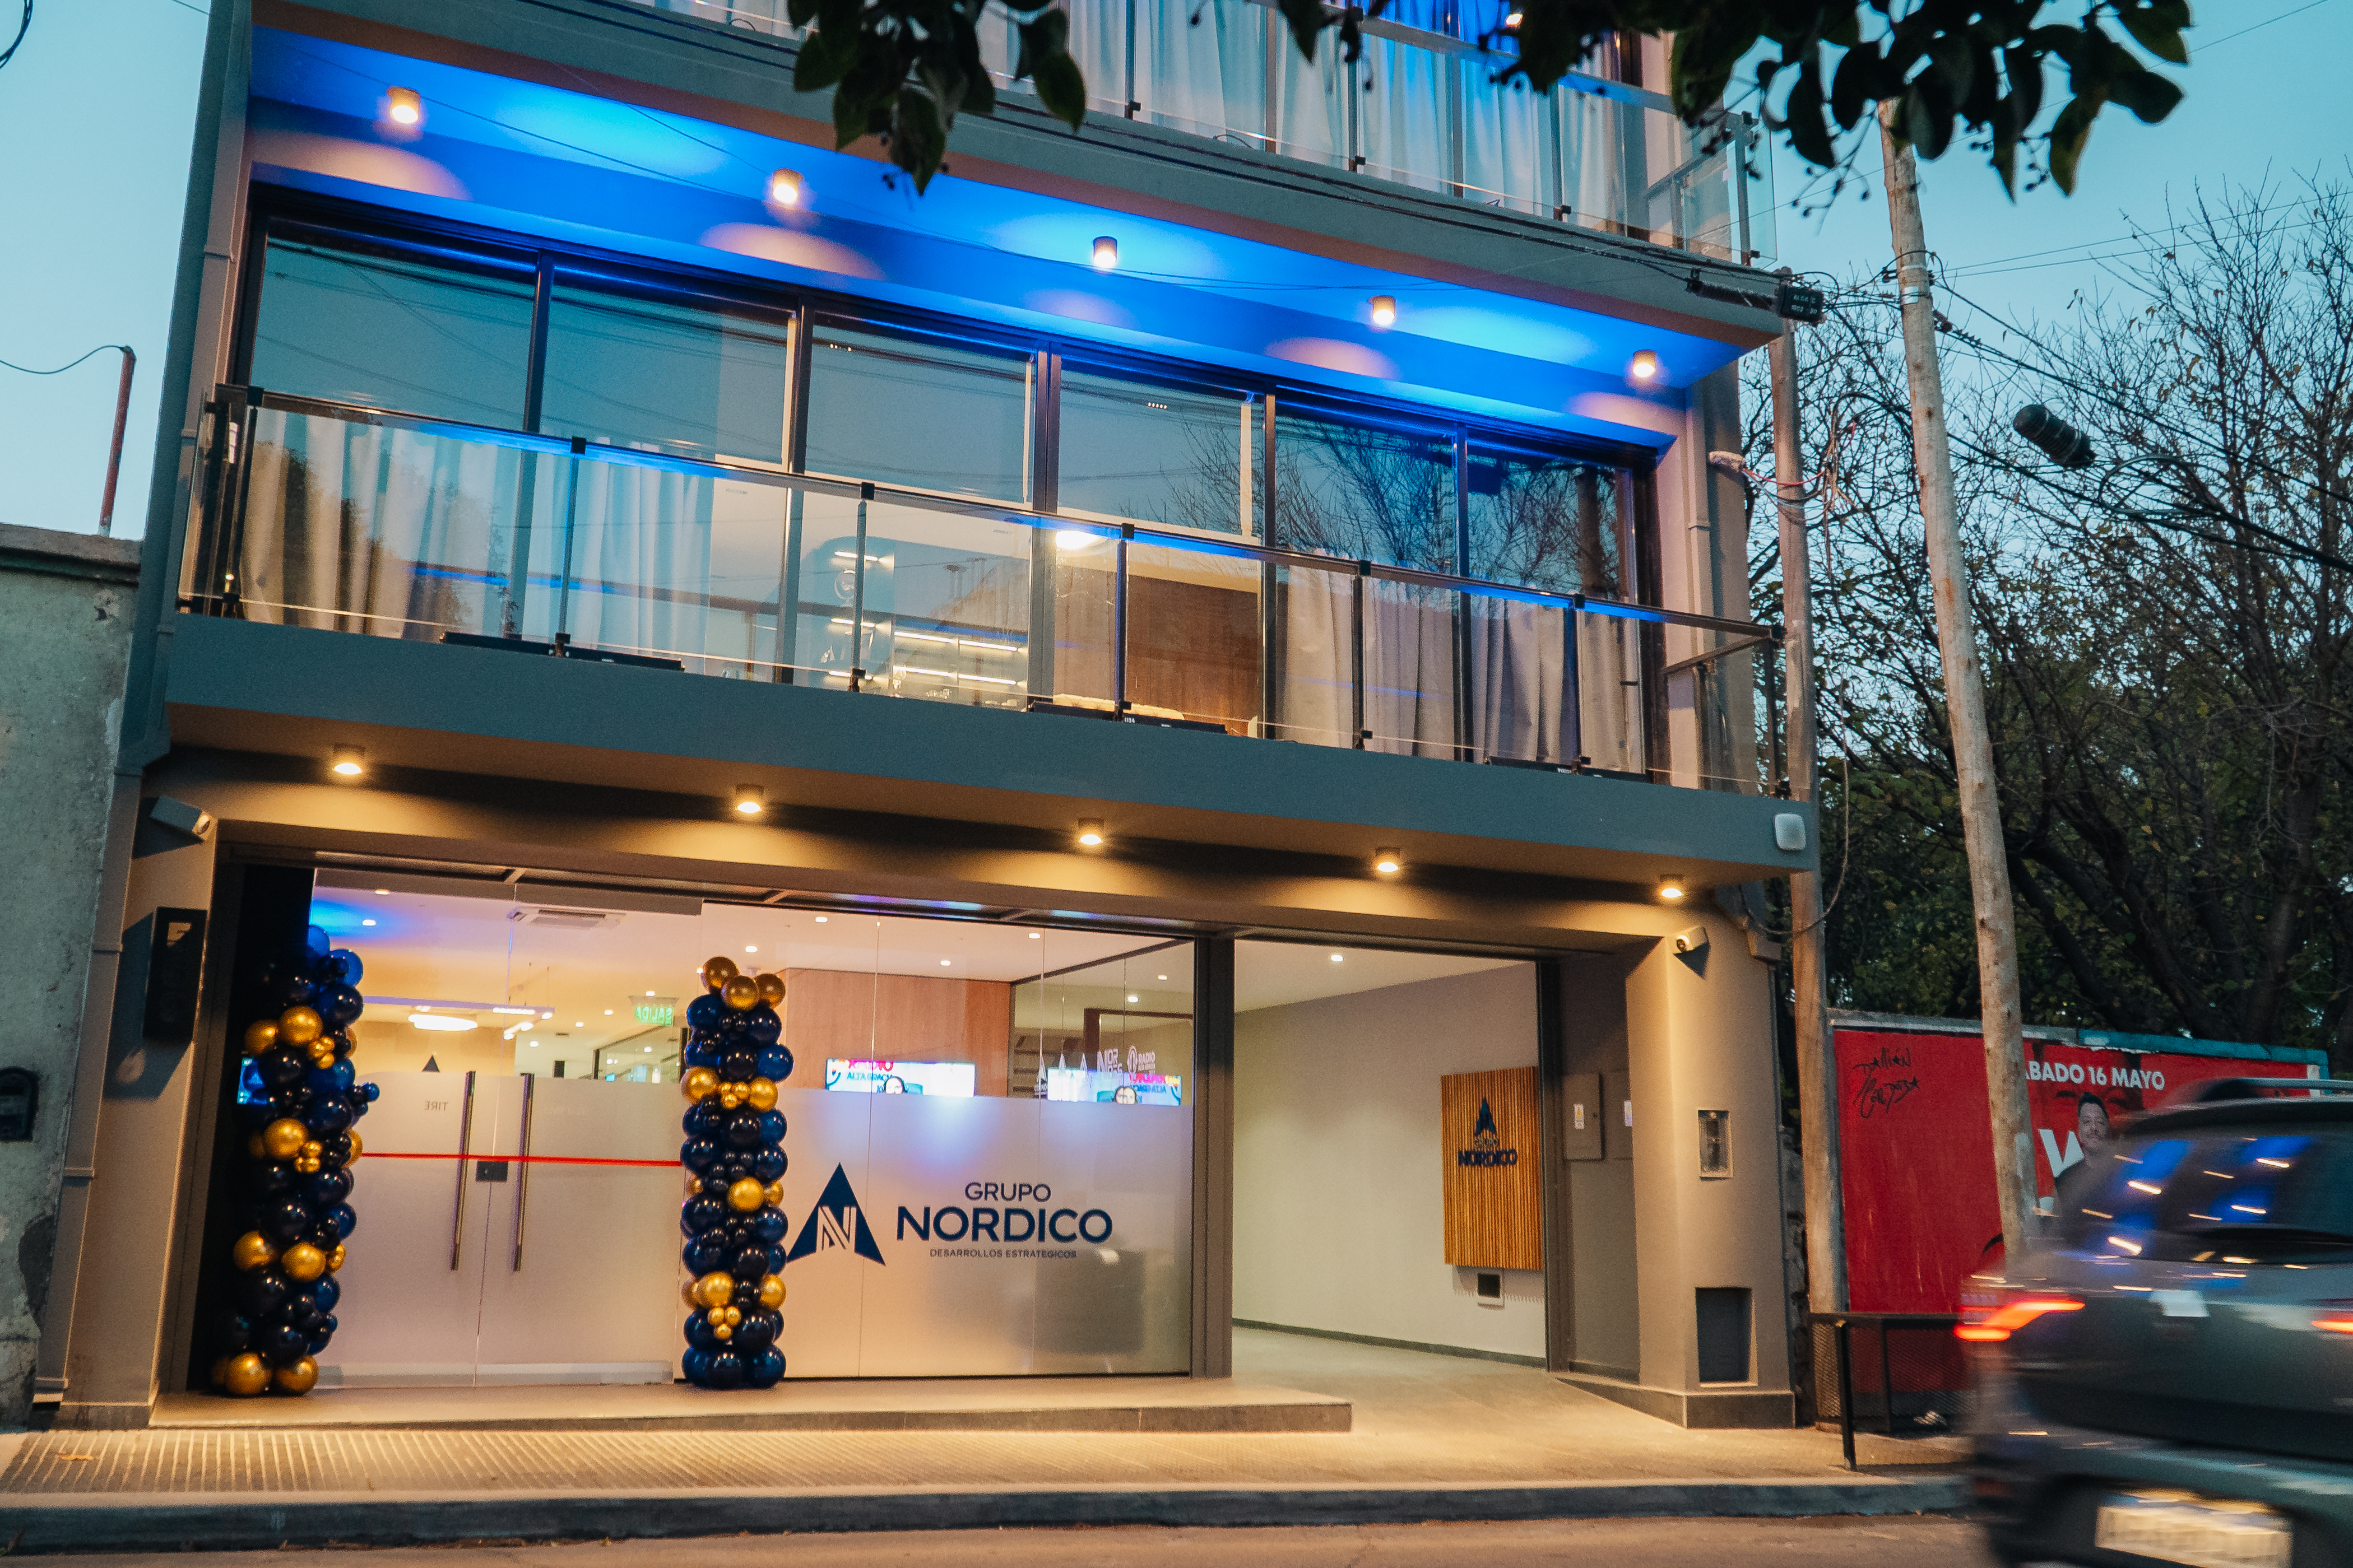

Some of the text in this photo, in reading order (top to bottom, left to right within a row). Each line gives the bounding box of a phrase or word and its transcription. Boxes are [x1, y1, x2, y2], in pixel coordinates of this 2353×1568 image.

[2026, 1061, 2165, 1090] BADO 16 MAYO
[1458, 1148, 1517, 1166] NORDICO
[965, 1182, 1051, 1202] GRUPO
[897, 1206, 1113, 1243] NORDICO
[930, 1248, 1076, 1259] DESARROLLOS ESTRATEGICOS
